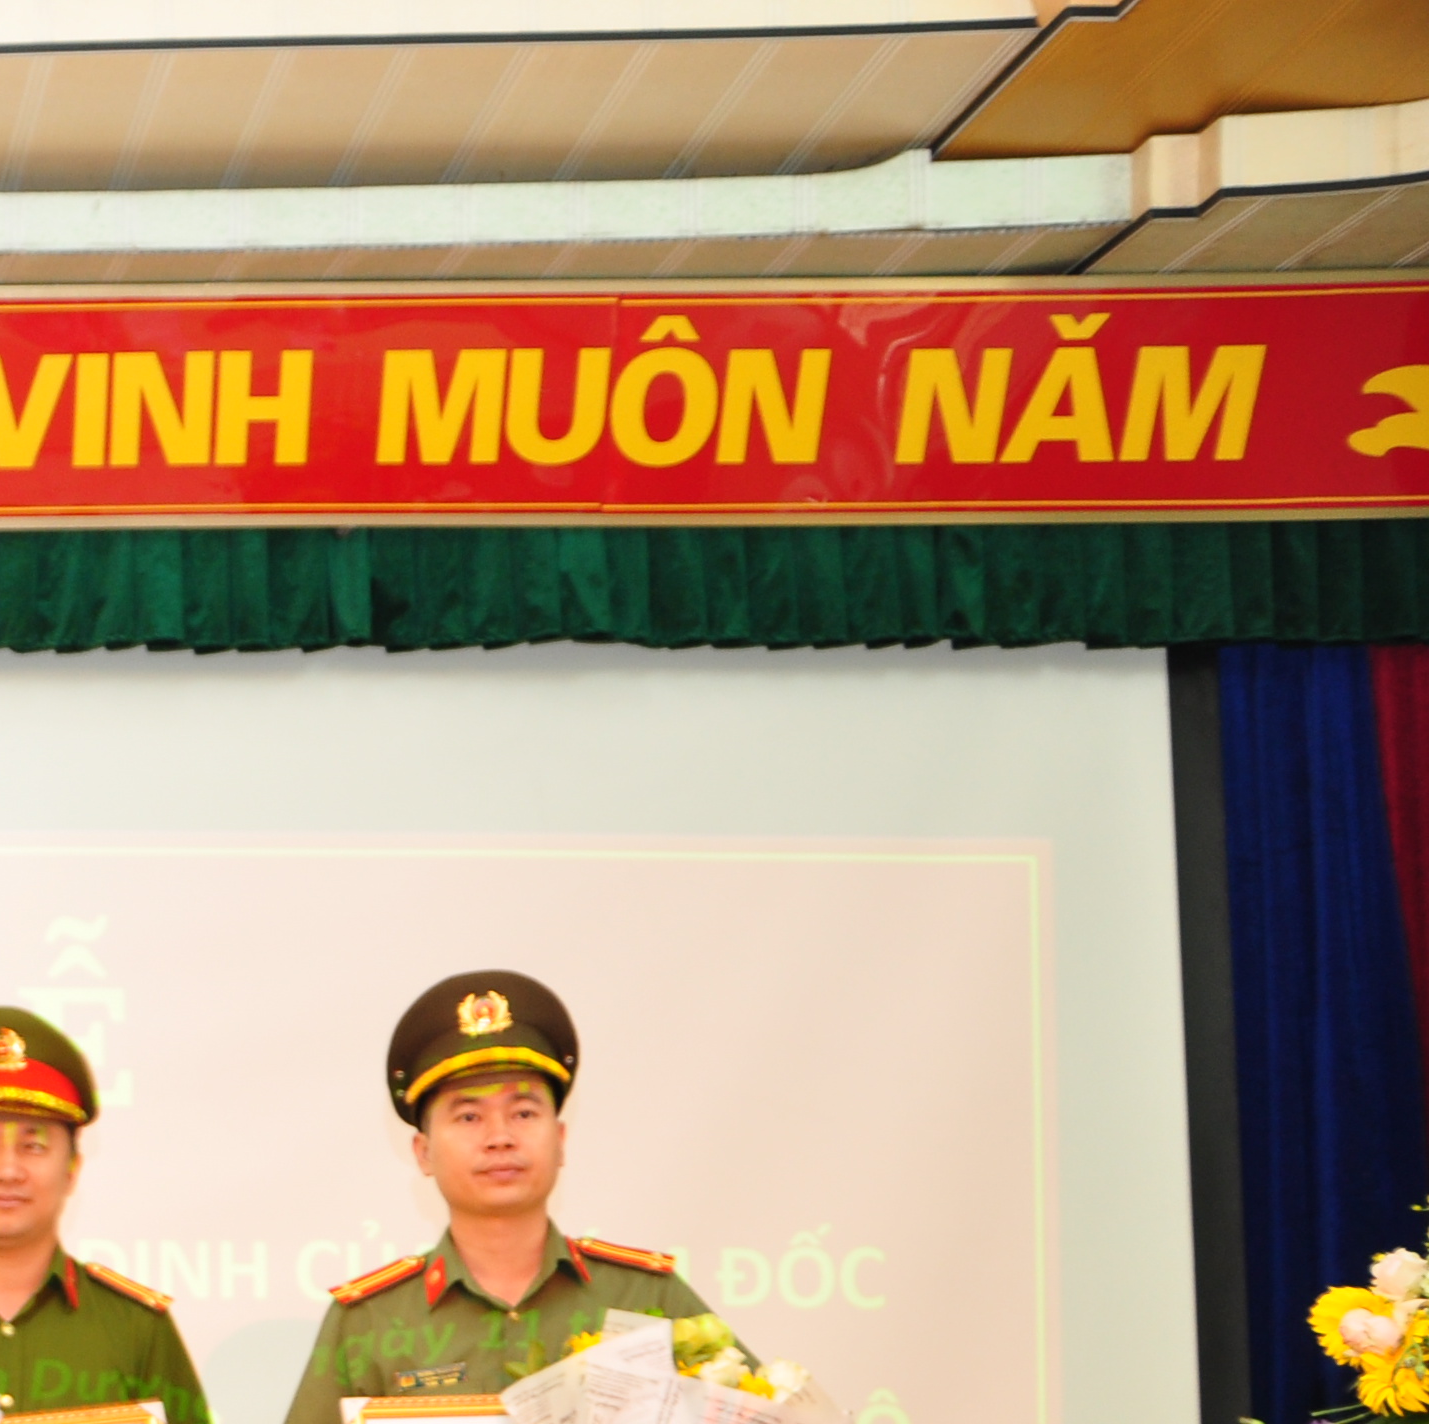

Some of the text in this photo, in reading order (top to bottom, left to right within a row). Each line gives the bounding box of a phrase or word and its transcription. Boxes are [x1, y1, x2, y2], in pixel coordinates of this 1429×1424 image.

[376, 314, 832, 467] MUÔN
[894, 312, 1266, 464] NĂM
[716, 1224, 888, 1309] ĐỐC
